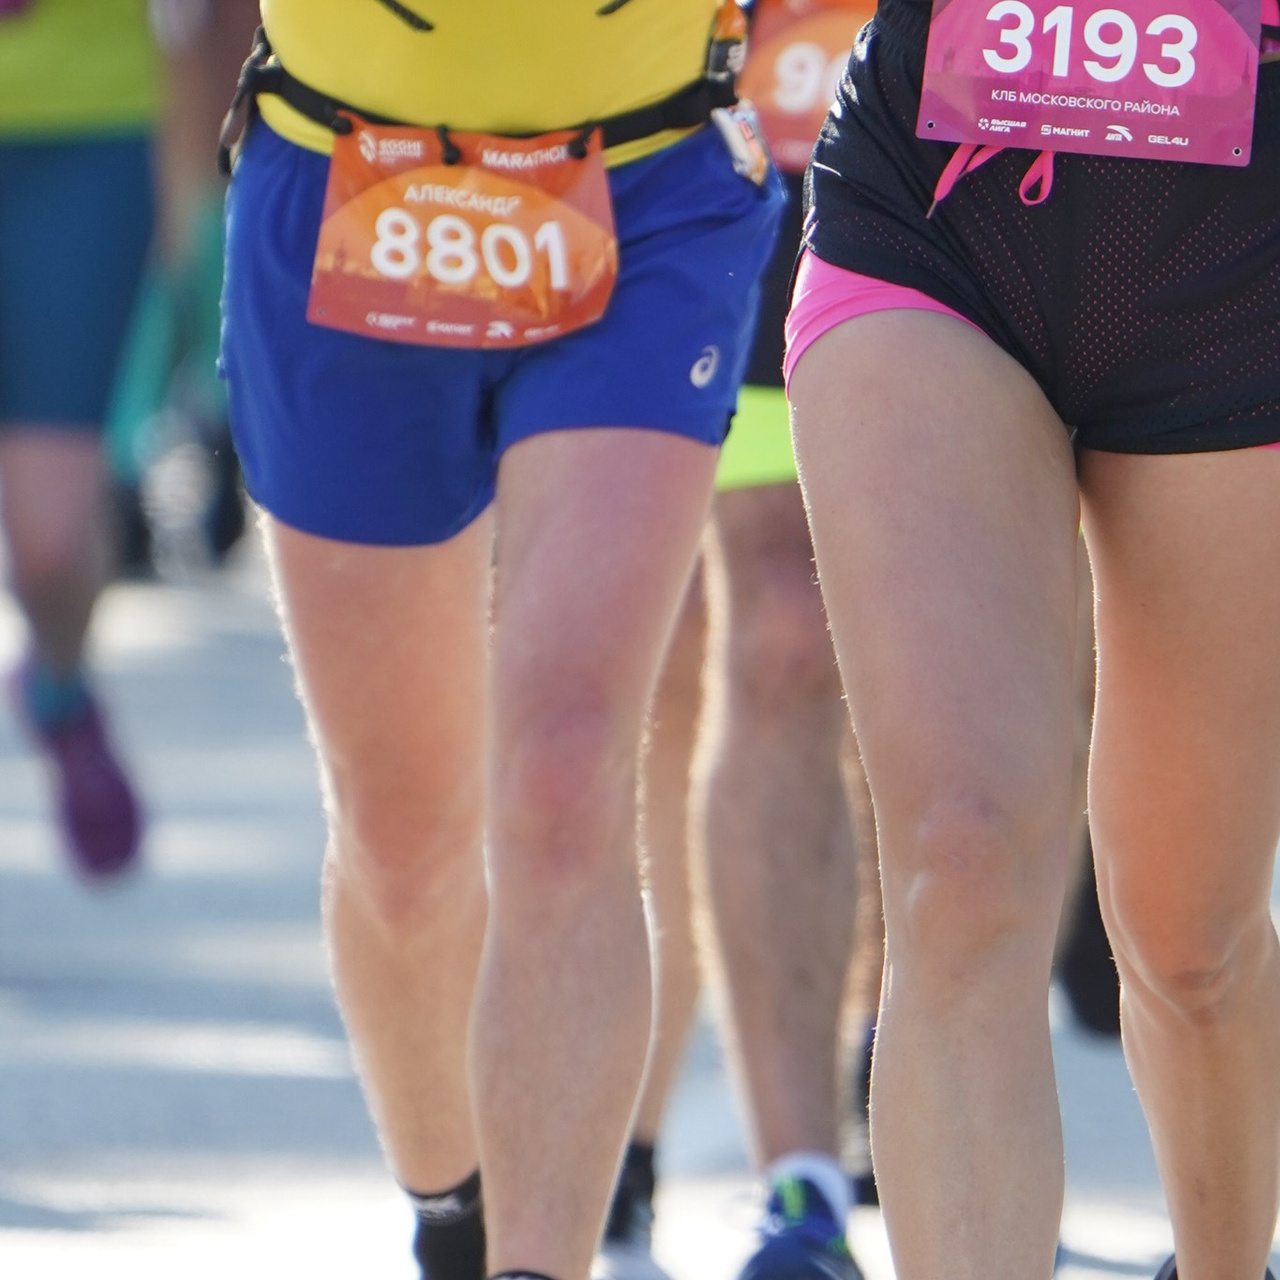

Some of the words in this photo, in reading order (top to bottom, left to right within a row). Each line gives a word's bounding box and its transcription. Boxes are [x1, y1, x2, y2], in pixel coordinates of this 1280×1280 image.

[982, 0, 1198, 88] 3193
[991, 89, 1017, 102] КЛБ
[1019, 91, 1122, 111] МОСКОВСКОГО
[1124, 100, 1180, 116] РАЙОНА
[989, 125, 1011, 133] ЛИГА
[1052, 127, 1090, 138] МАГНИТ
[1148, 135, 1189, 146] GEL4U
[403, 184, 521, 217] АЛЕКСАНДР
[370, 207, 569, 291] 8801
